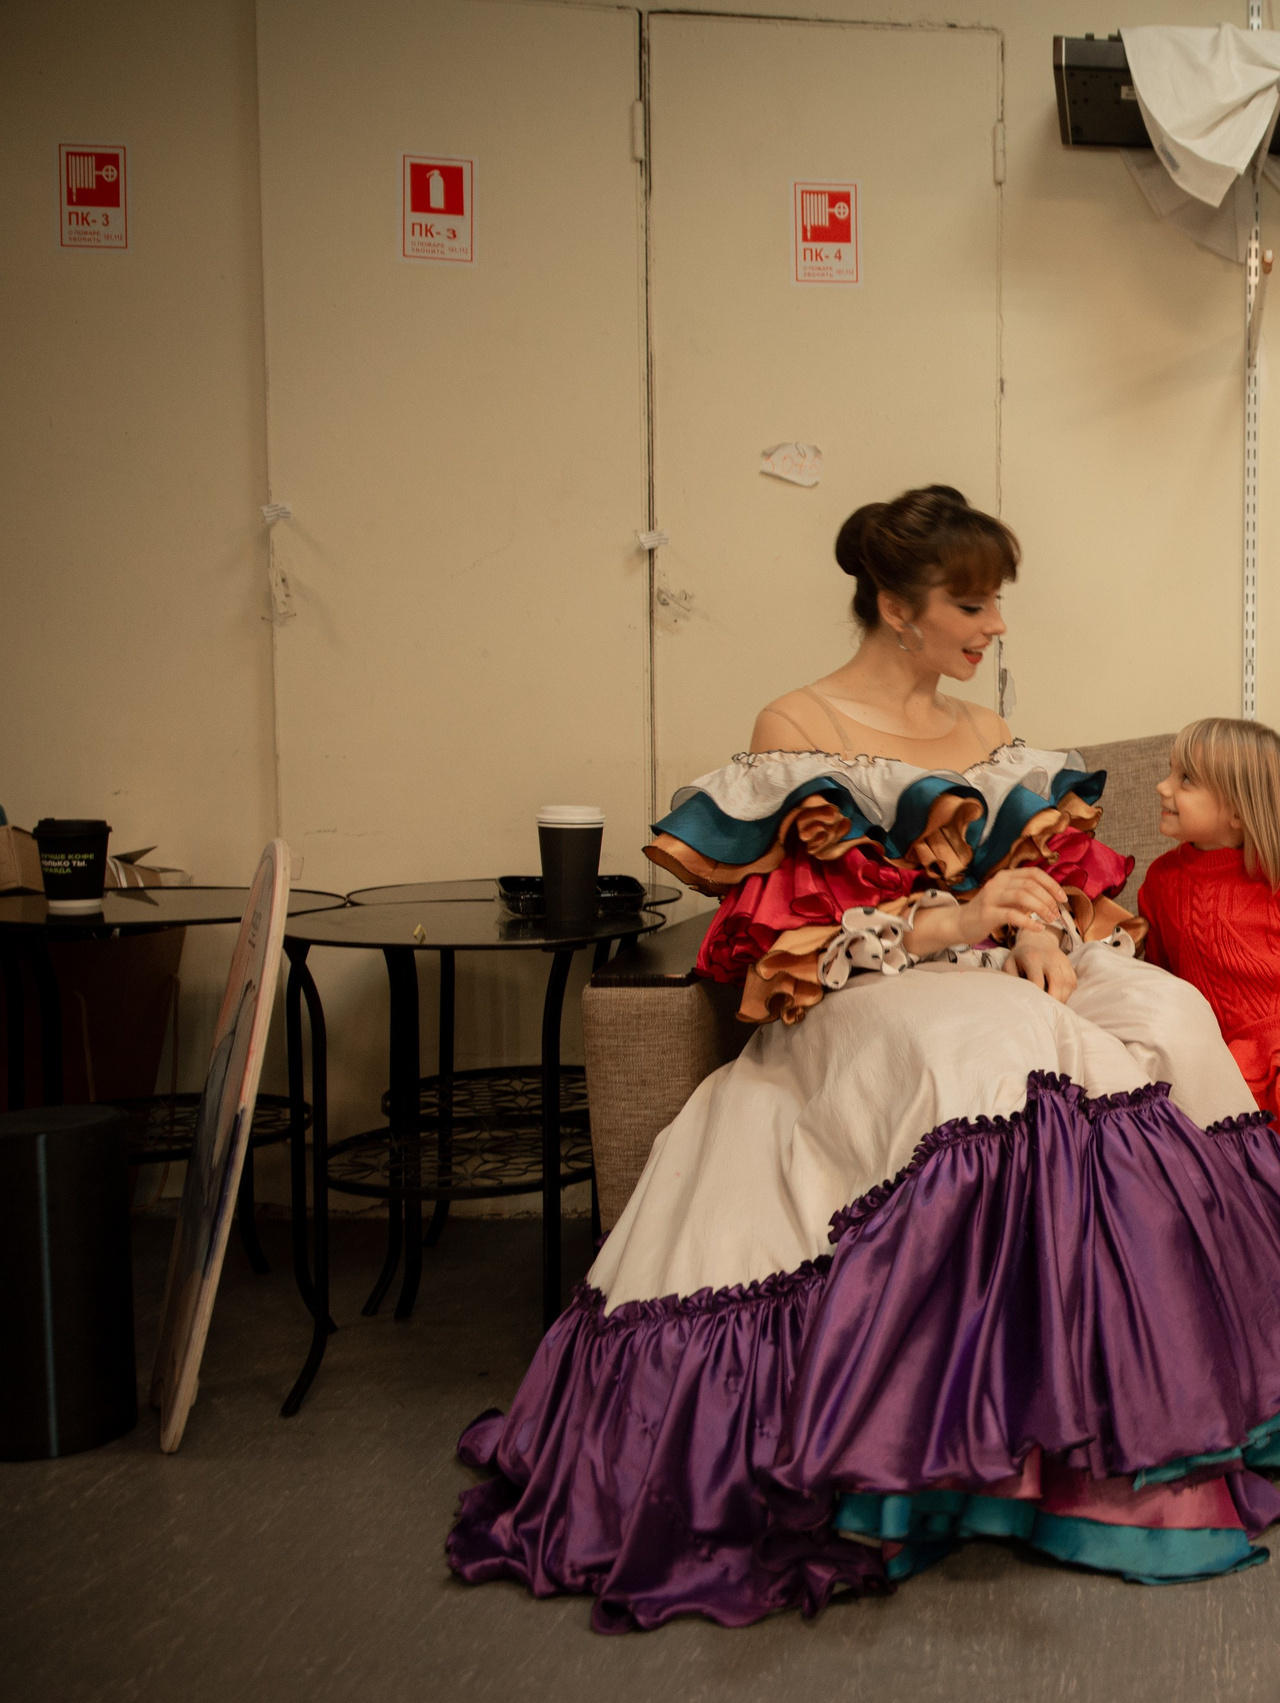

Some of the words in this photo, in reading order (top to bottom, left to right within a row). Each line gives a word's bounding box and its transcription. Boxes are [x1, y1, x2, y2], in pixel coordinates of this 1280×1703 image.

[101, 213, 110, 227] 3
[446, 228, 457, 240] 3
[834, 248, 842, 261] 4
[67, 852, 95, 860] КОФЕ
